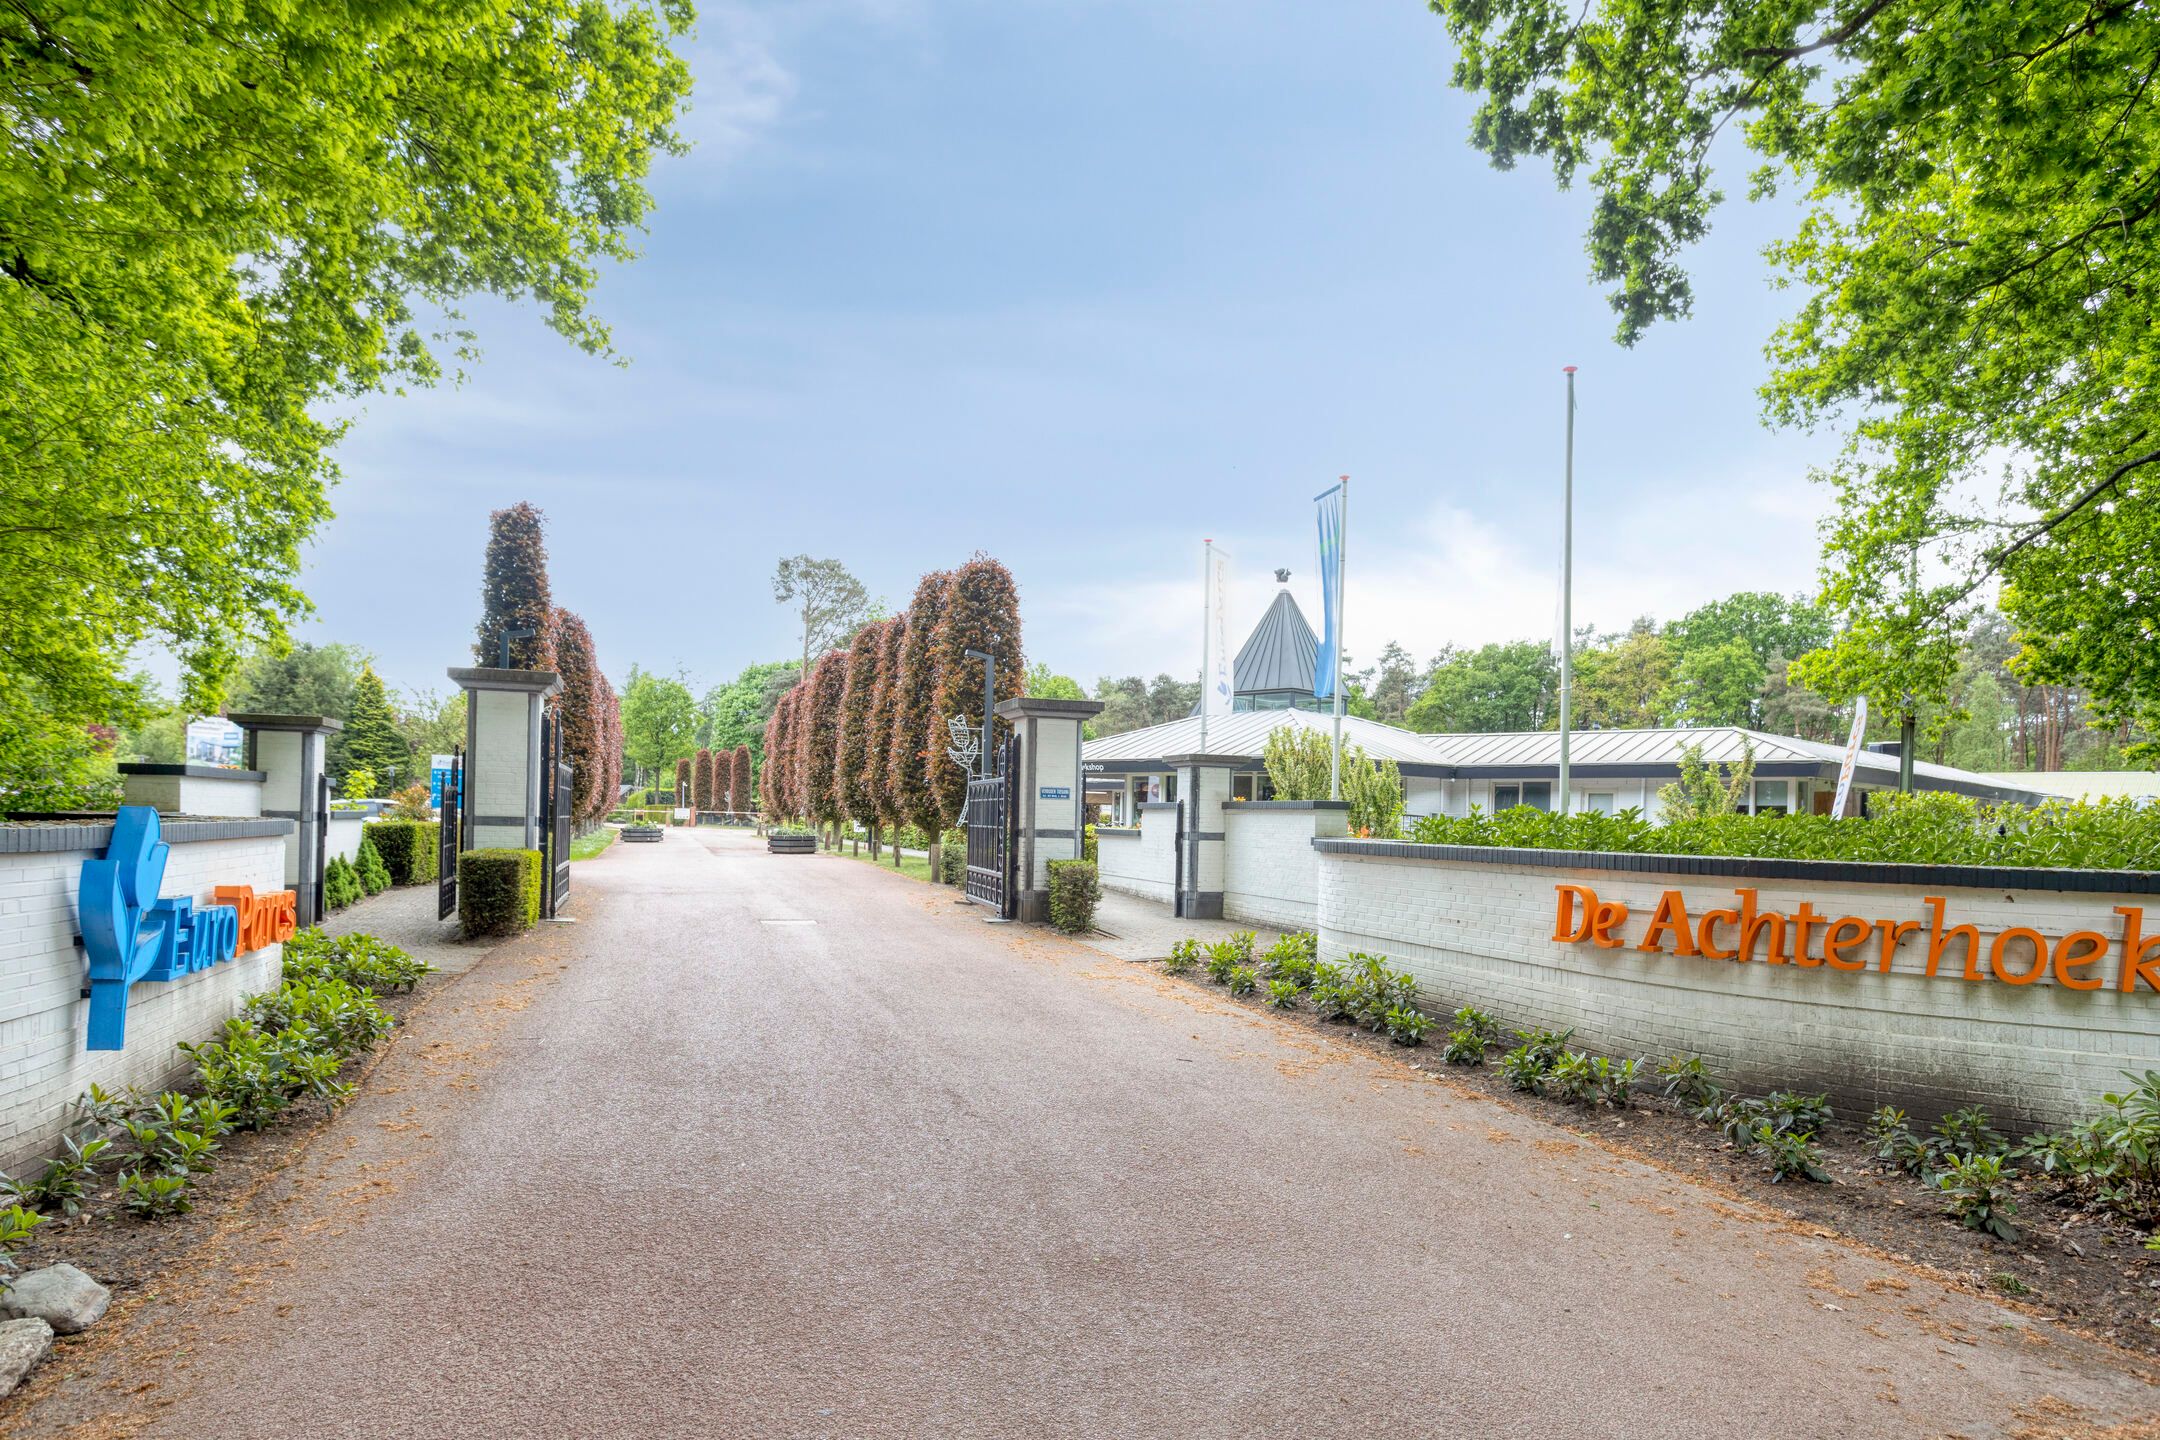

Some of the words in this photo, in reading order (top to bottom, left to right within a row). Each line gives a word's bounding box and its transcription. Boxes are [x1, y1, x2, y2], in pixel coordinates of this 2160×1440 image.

[156, 884, 297, 982] EuroParcs
[1551, 884, 1629, 949] De
[1636, 887, 2160, 993] Achterhoek
